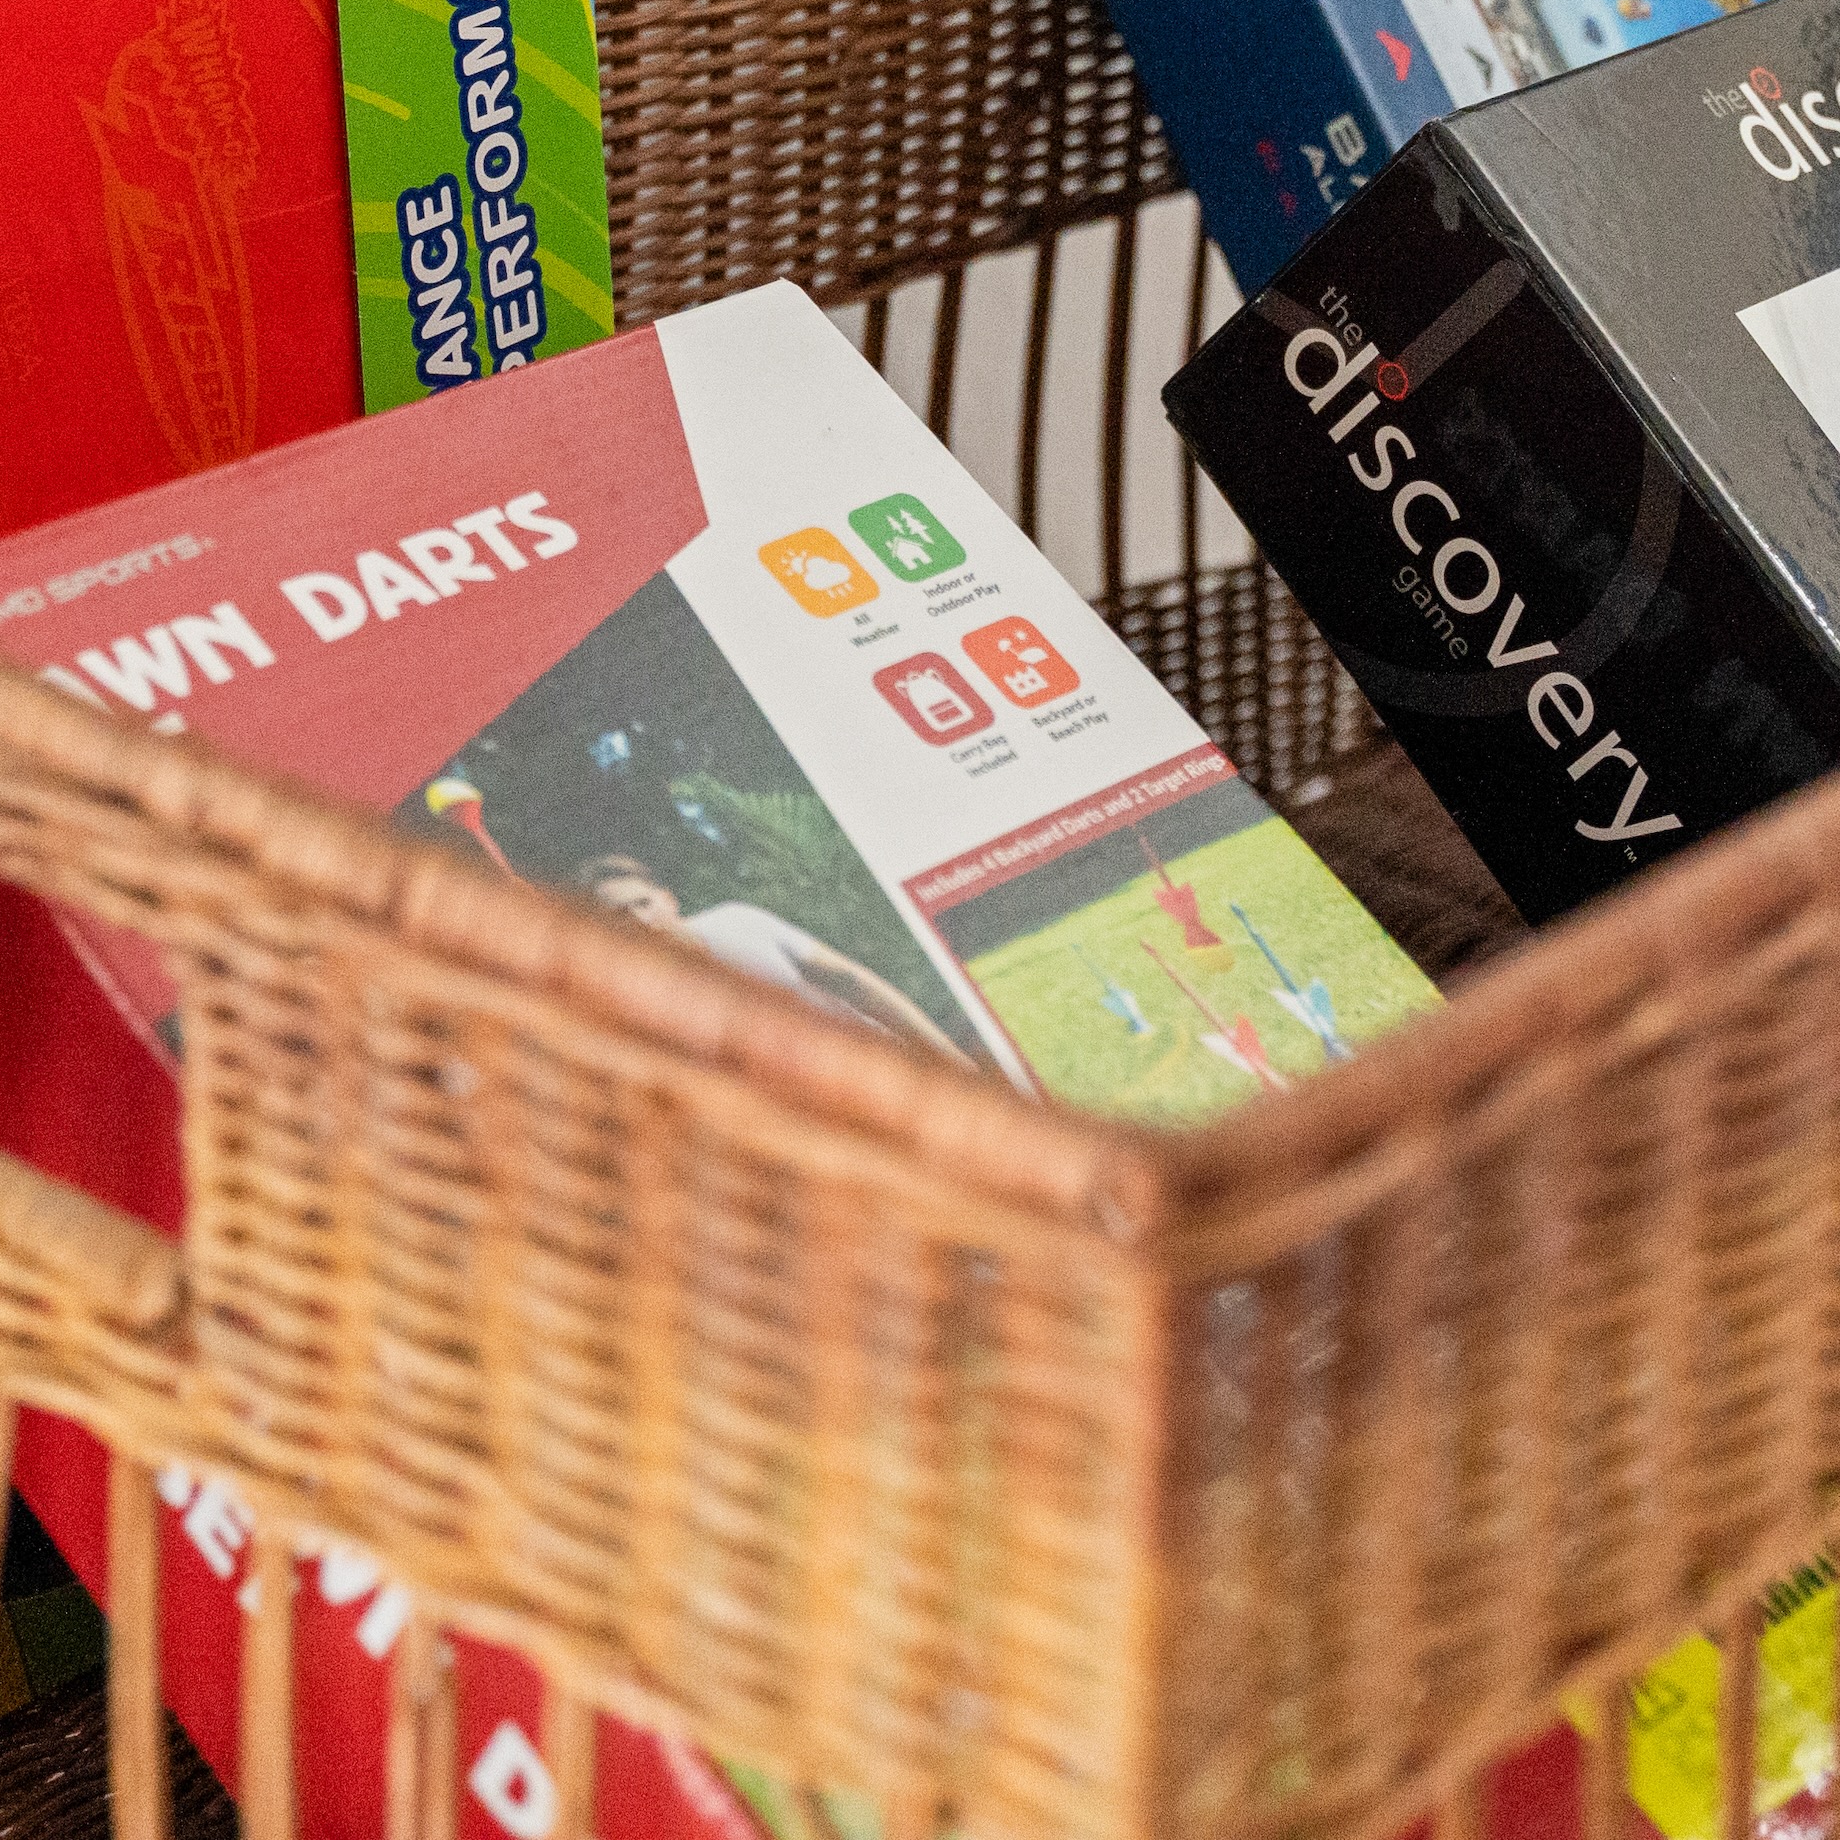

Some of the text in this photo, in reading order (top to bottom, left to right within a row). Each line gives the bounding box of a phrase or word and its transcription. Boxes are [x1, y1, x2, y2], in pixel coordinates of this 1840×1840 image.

[1702, 87, 1747, 120] the
[1317, 285, 1364, 344] the
[47, 533, 204, 606] SPORTS
[280, 491, 579, 643] DARTS
[923, 577, 961, 599] Indoor
[927, 581, 1001, 618] Outdoor Play
[1284, 328, 1684, 842] discovery
[1391, 564, 1469, 661] game
[991, 821, 1066, 871] Backyard
[1058, 803, 1105, 838] Darts
[1100, 790, 1135, 819] and
[1140, 764, 1191, 804] Target
